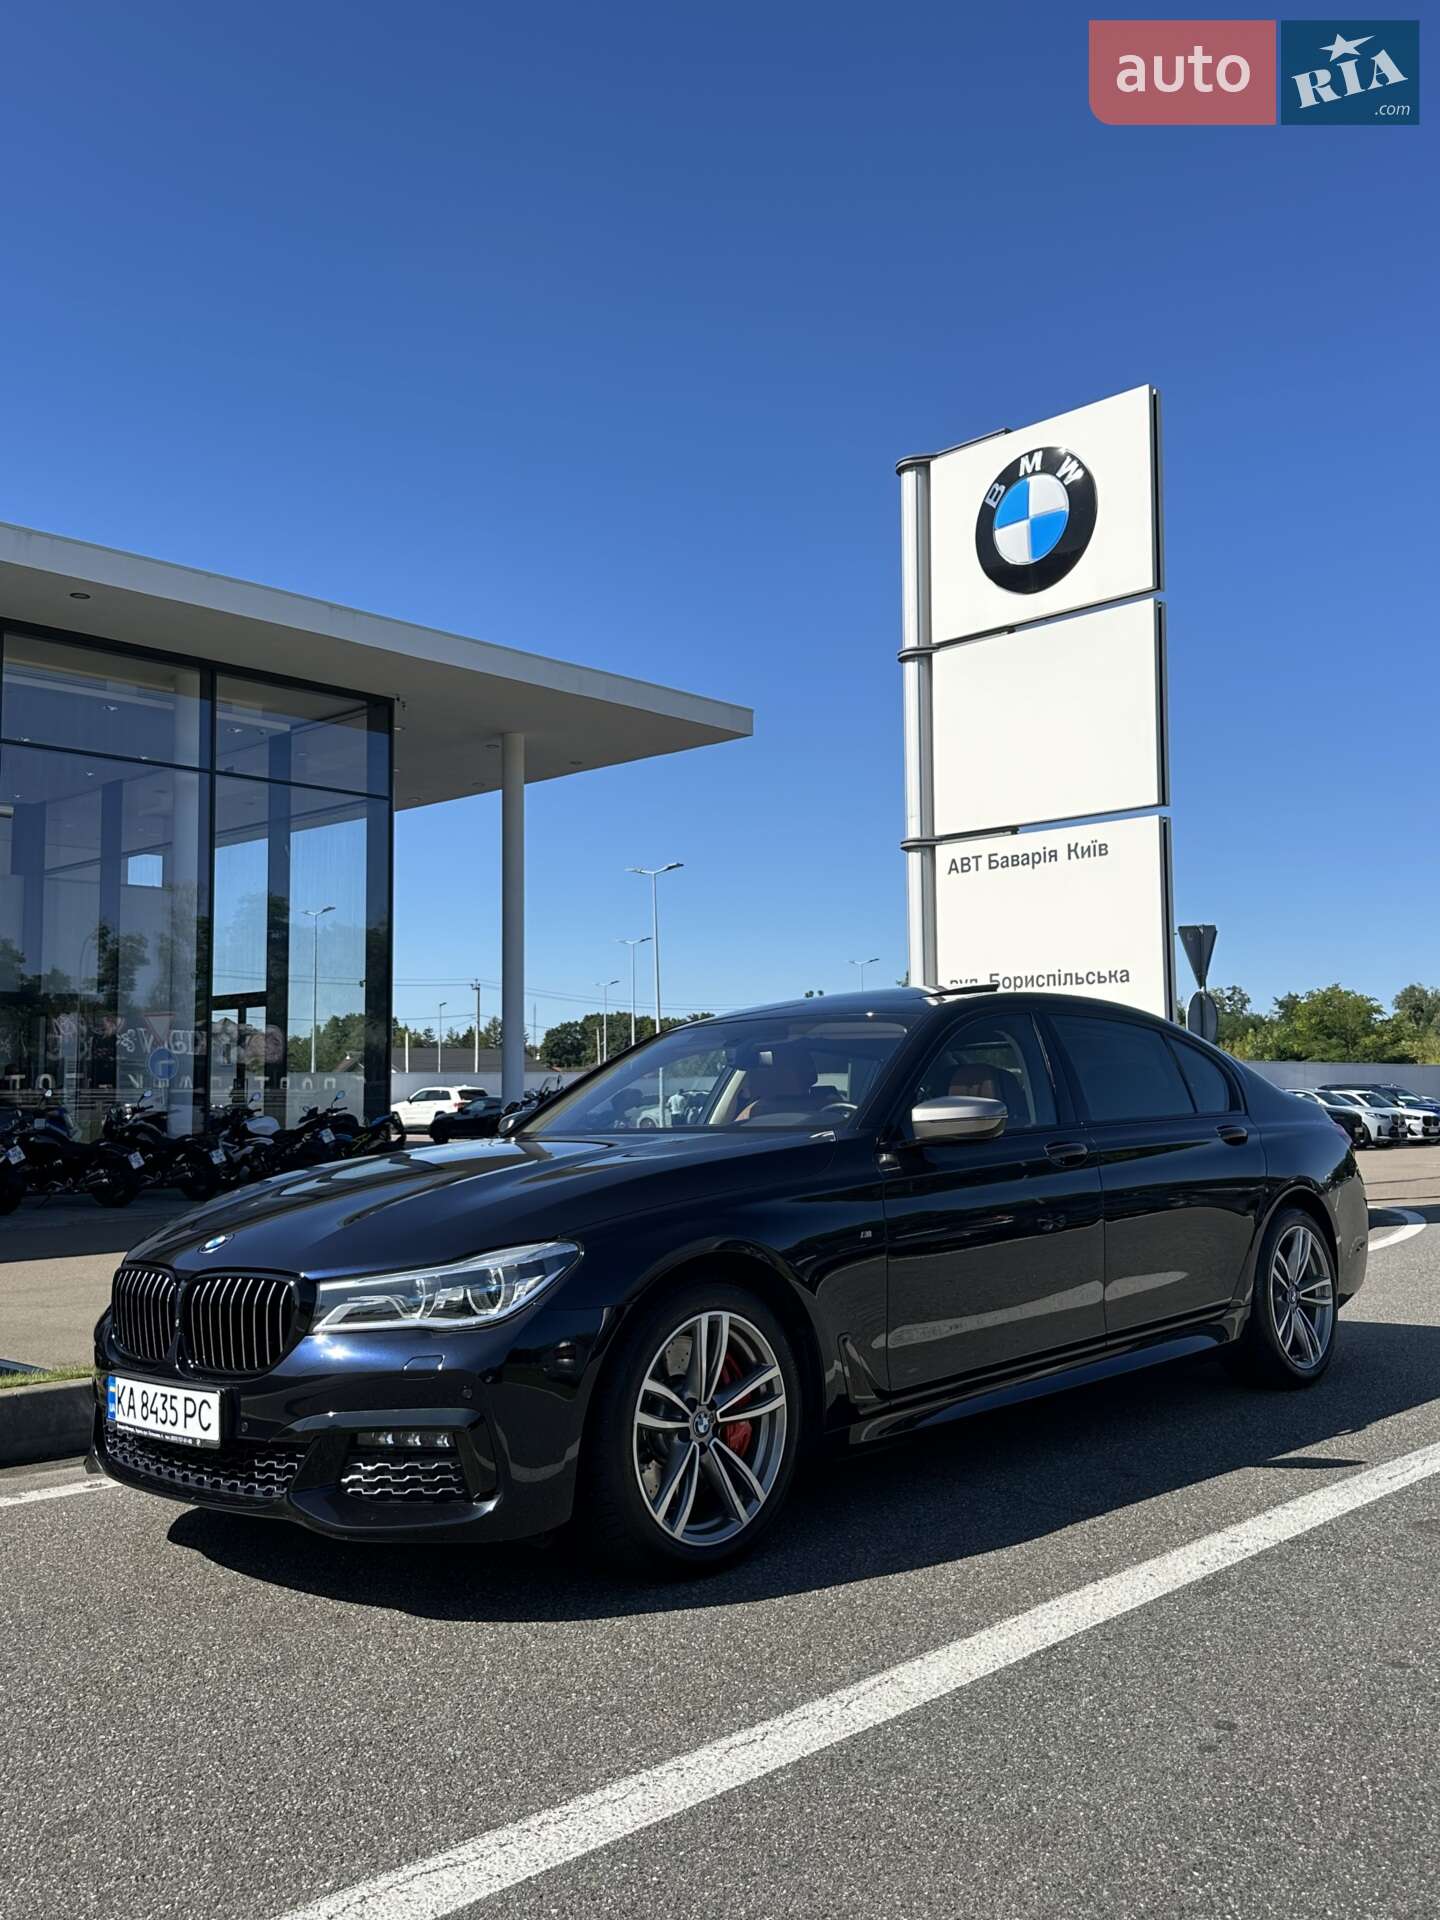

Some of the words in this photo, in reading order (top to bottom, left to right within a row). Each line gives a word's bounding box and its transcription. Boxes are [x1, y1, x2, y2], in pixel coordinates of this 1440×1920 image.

[985, 451, 1085, 509] BMW
[947, 855, 983, 875] АВТ
[987, 846, 1058, 869] Баварія
[1066, 840, 1109, 860] Київ
[989, 969, 1131, 991] Бориспільська
[140, 1390, 178, 1427] 8435
